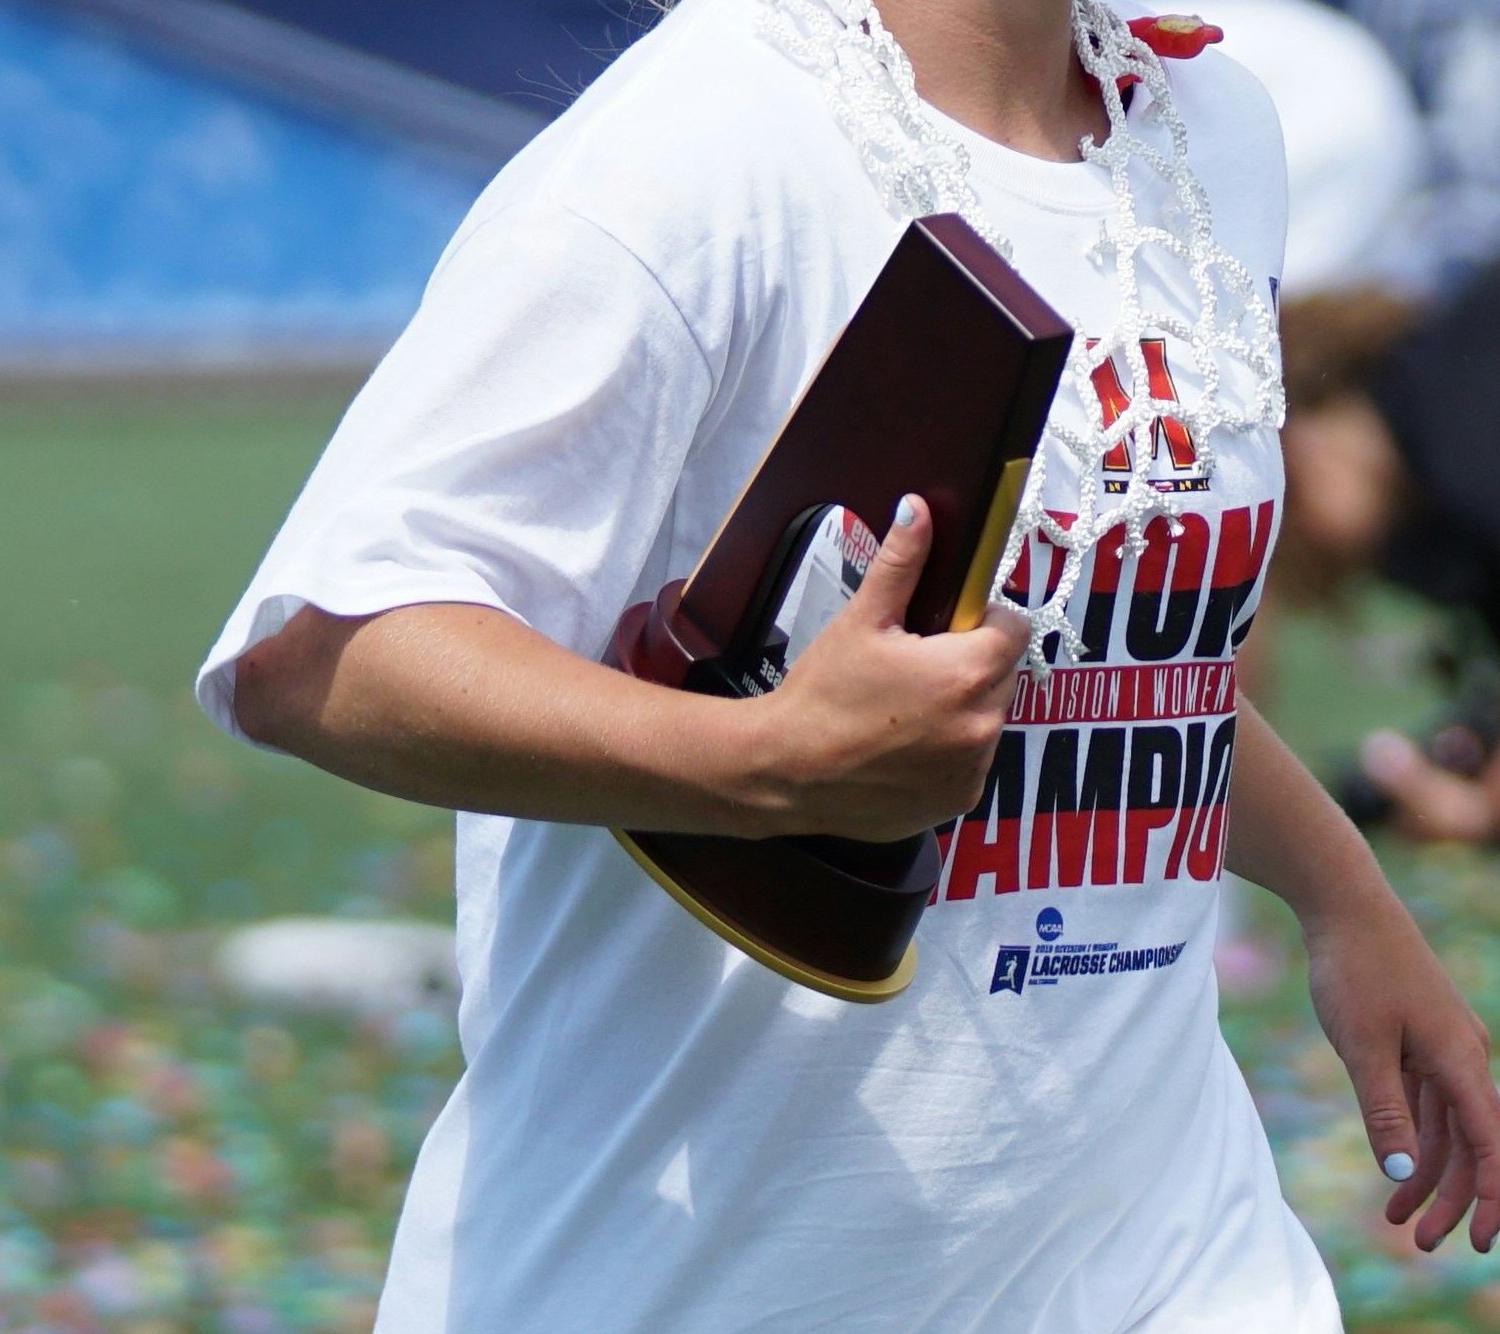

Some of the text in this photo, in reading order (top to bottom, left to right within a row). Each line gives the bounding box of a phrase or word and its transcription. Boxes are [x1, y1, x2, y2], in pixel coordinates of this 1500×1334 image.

[1012, 669, 1121, 721] DIVISION
[1133, 669, 1140, 717] I
[927, 715, 1236, 906] AMPIO
[1031, 953, 1108, 976] LACROSSE
